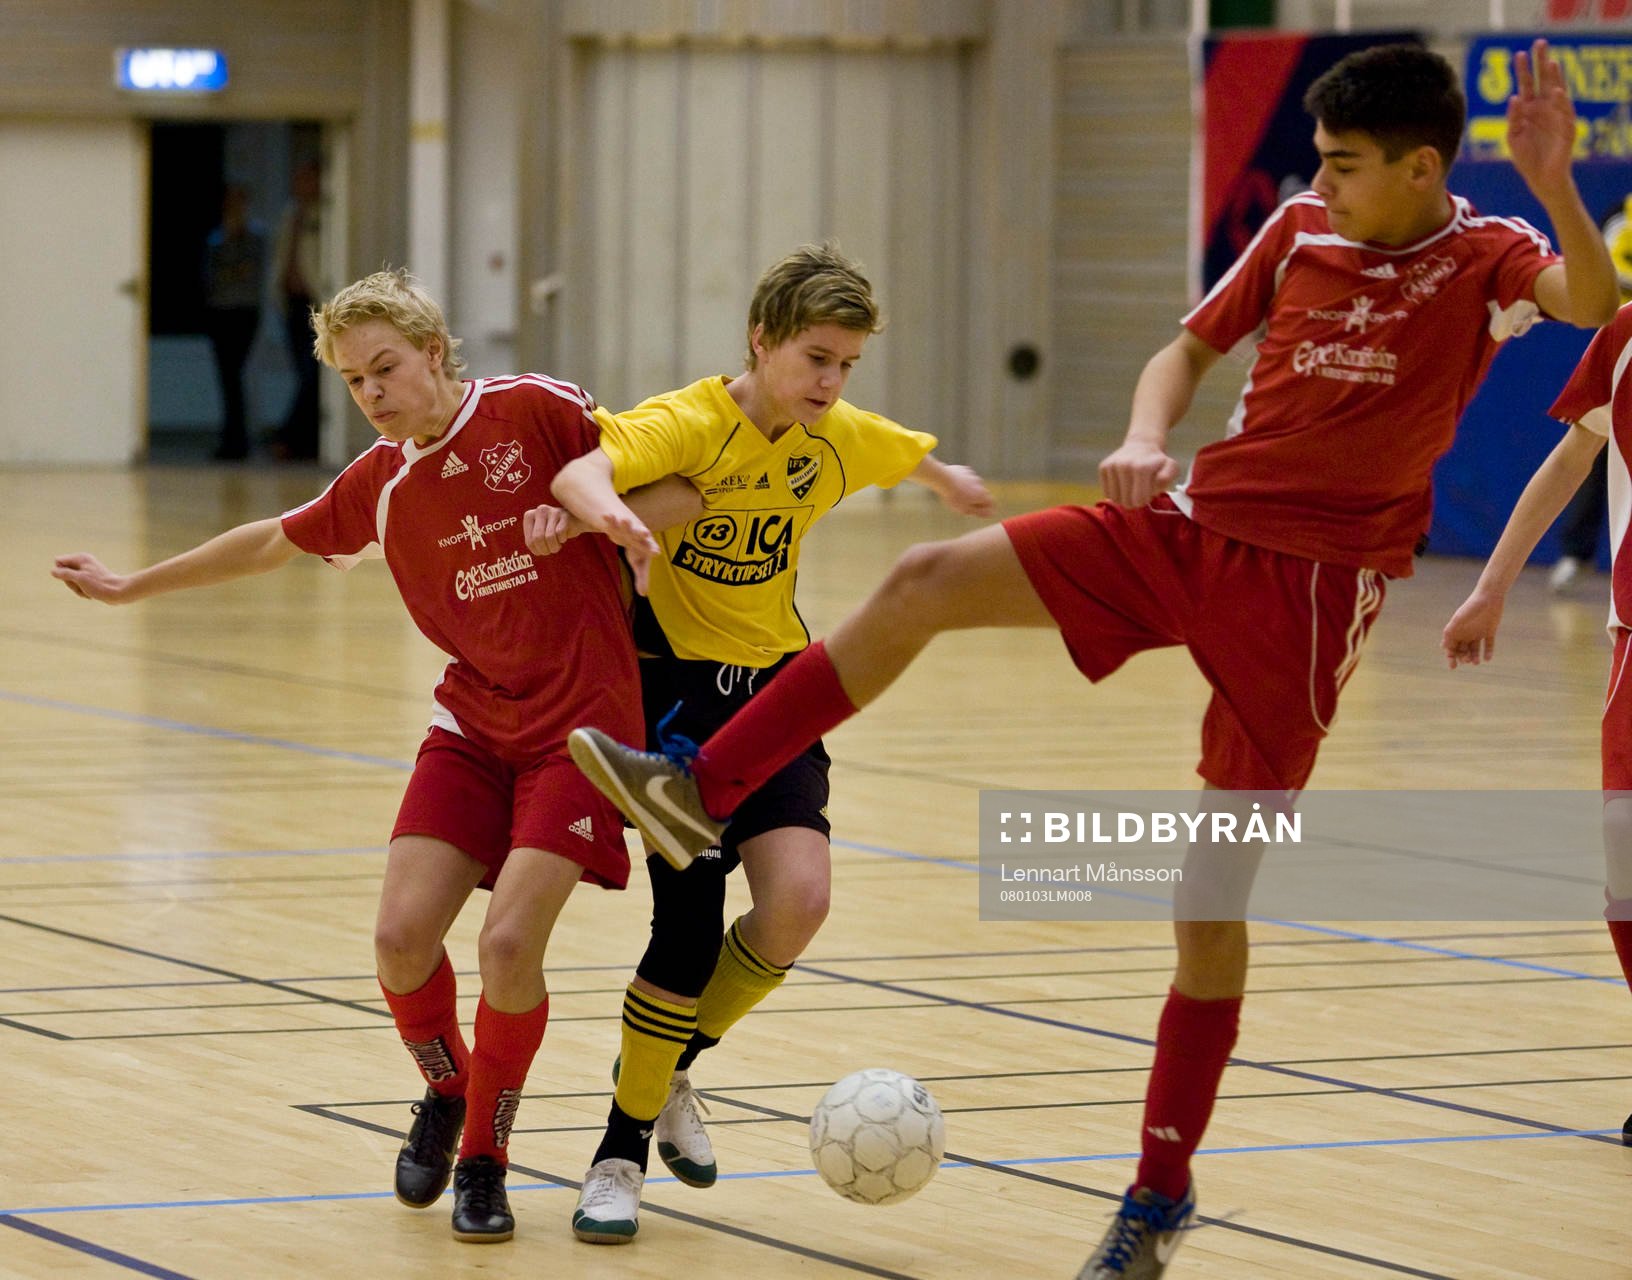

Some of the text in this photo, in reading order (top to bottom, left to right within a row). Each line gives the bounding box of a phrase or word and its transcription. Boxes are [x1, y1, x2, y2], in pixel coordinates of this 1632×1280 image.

[441, 463, 469, 479] adidas
[506, 470, 523, 482] BK
[700, 523, 730, 541] 13
[745, 515, 794, 555] ICA
[479, 574, 527, 597] KRISTIANSTAD
[527, 570, 539, 583] AB
